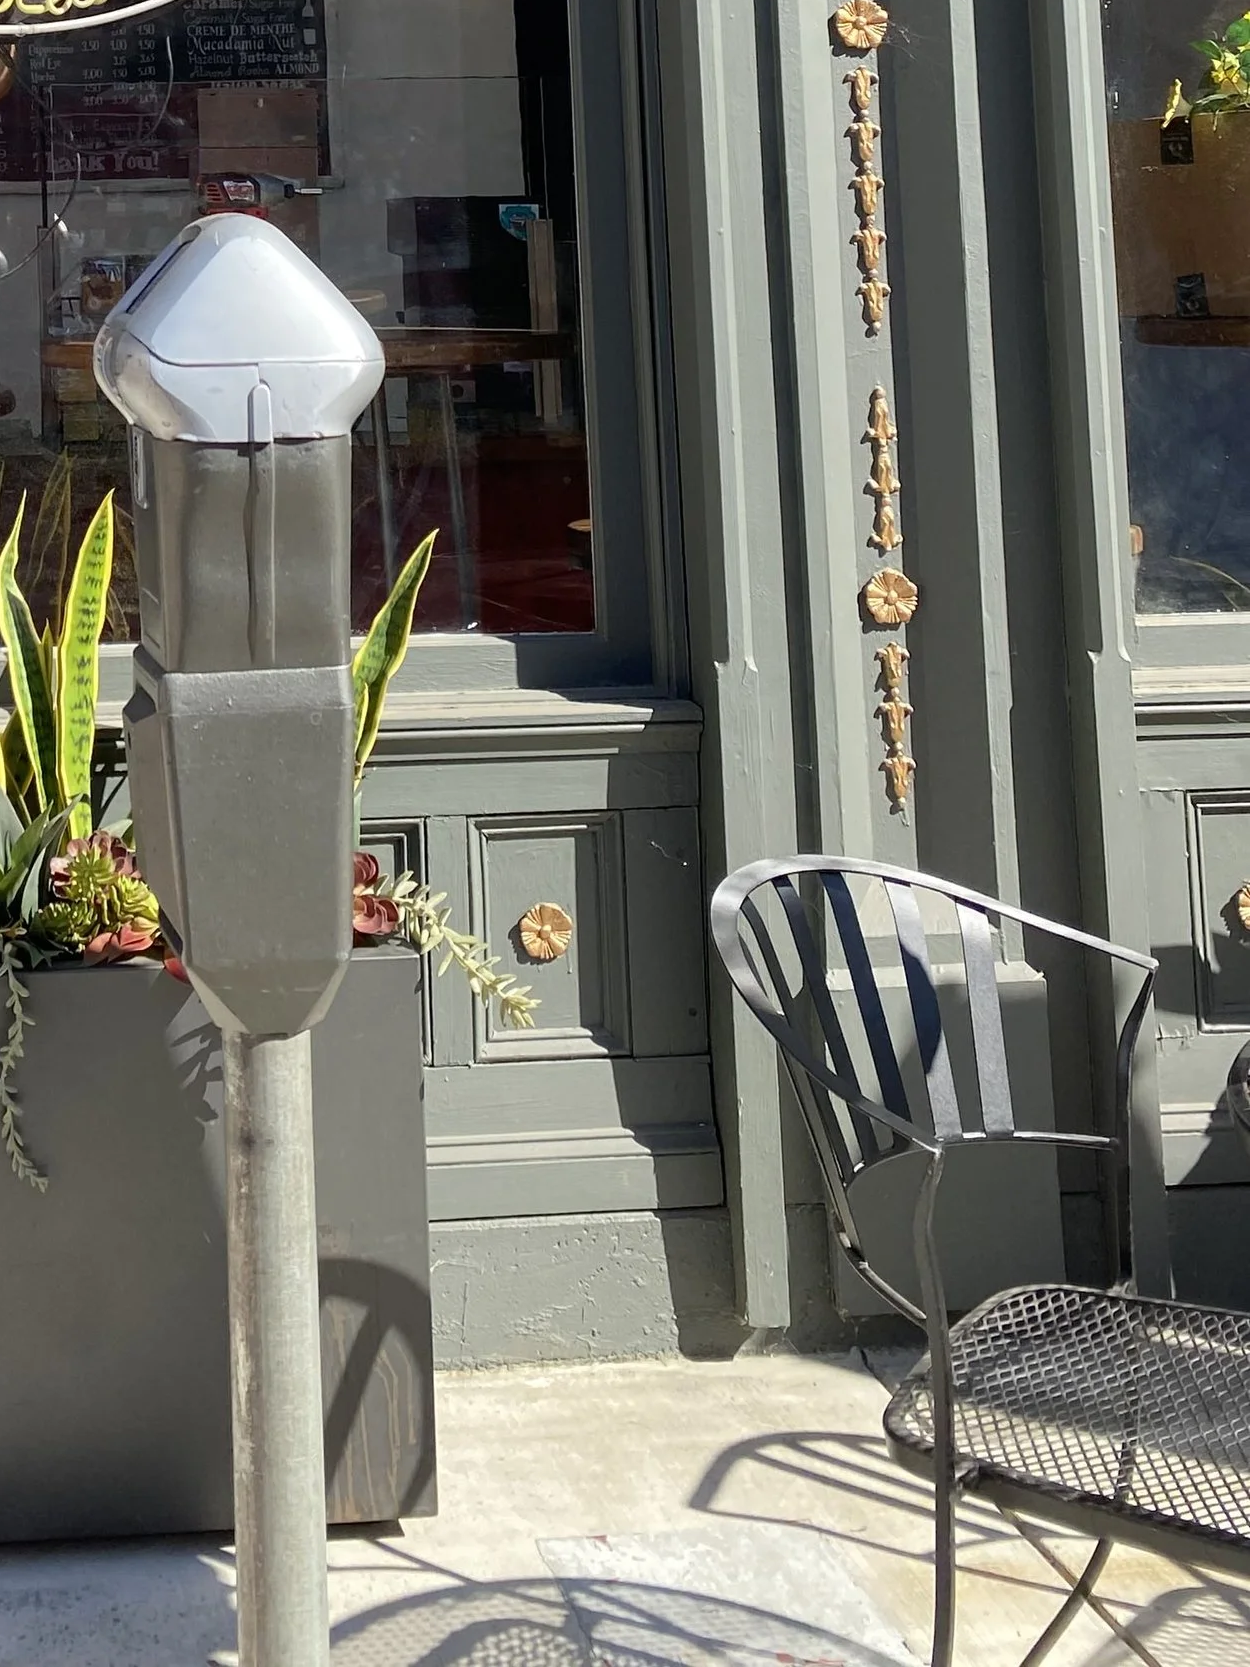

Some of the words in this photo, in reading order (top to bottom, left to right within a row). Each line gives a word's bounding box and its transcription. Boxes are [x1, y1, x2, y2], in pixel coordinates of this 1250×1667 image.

[186, 25, 227, 36] CREME
[231, 24, 247, 36] DE
[250, 23, 296, 36] MENTHE
[186, 34, 264, 55] Macadamia
[274, 62, 319, 75] ALMOND
